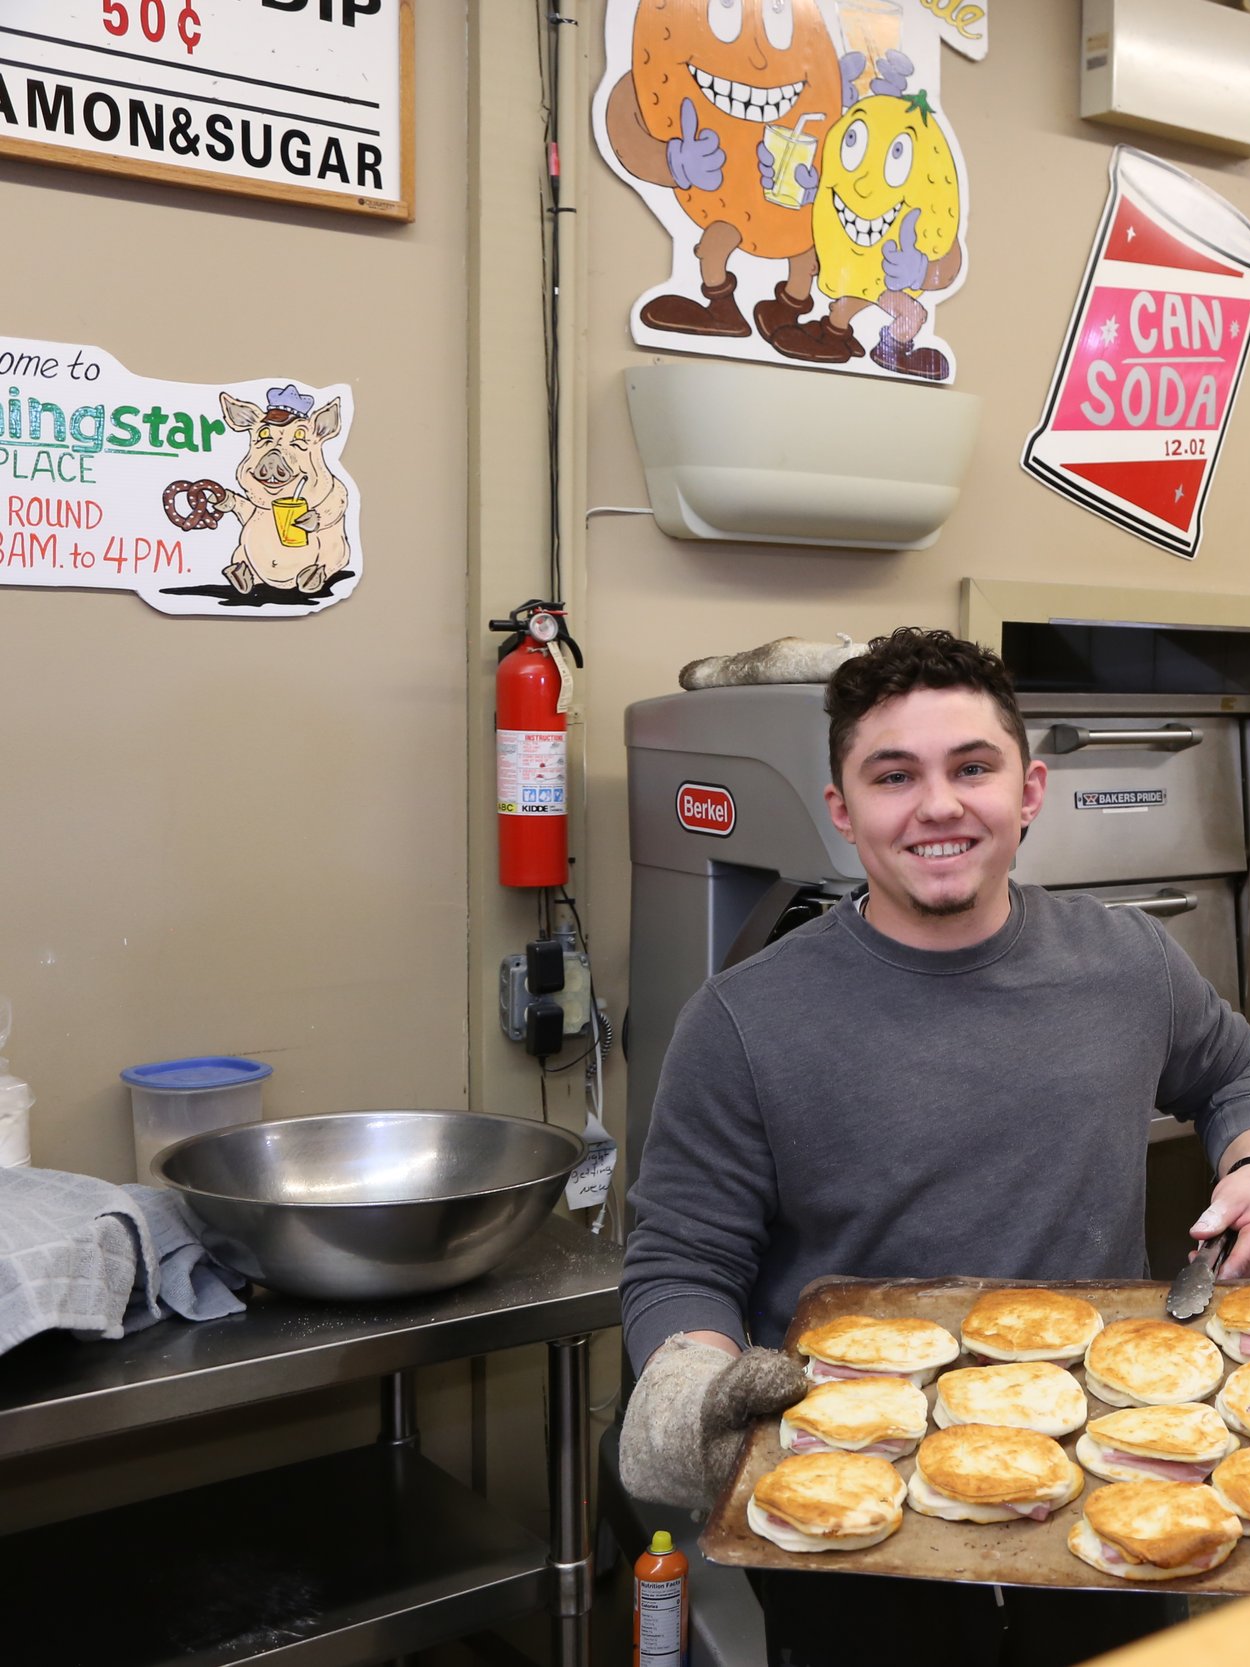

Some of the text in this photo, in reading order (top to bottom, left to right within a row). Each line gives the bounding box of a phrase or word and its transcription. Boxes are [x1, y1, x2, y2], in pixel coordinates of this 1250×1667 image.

[261, 0, 382, 27] IP
[1129, 291, 1224, 353] CAN
[67, 350, 101, 381] to
[1079, 359, 1219, 427] SODA
[0, 386, 226, 453] ingstar
[8, 495, 103, 530] ROUND
[69, 542, 96, 569] to
[521, 805, 549, 813] KIDDE
[684, 795, 728, 823] Berkel
[1099, 791, 1162, 804] BAKERS PRIDE
